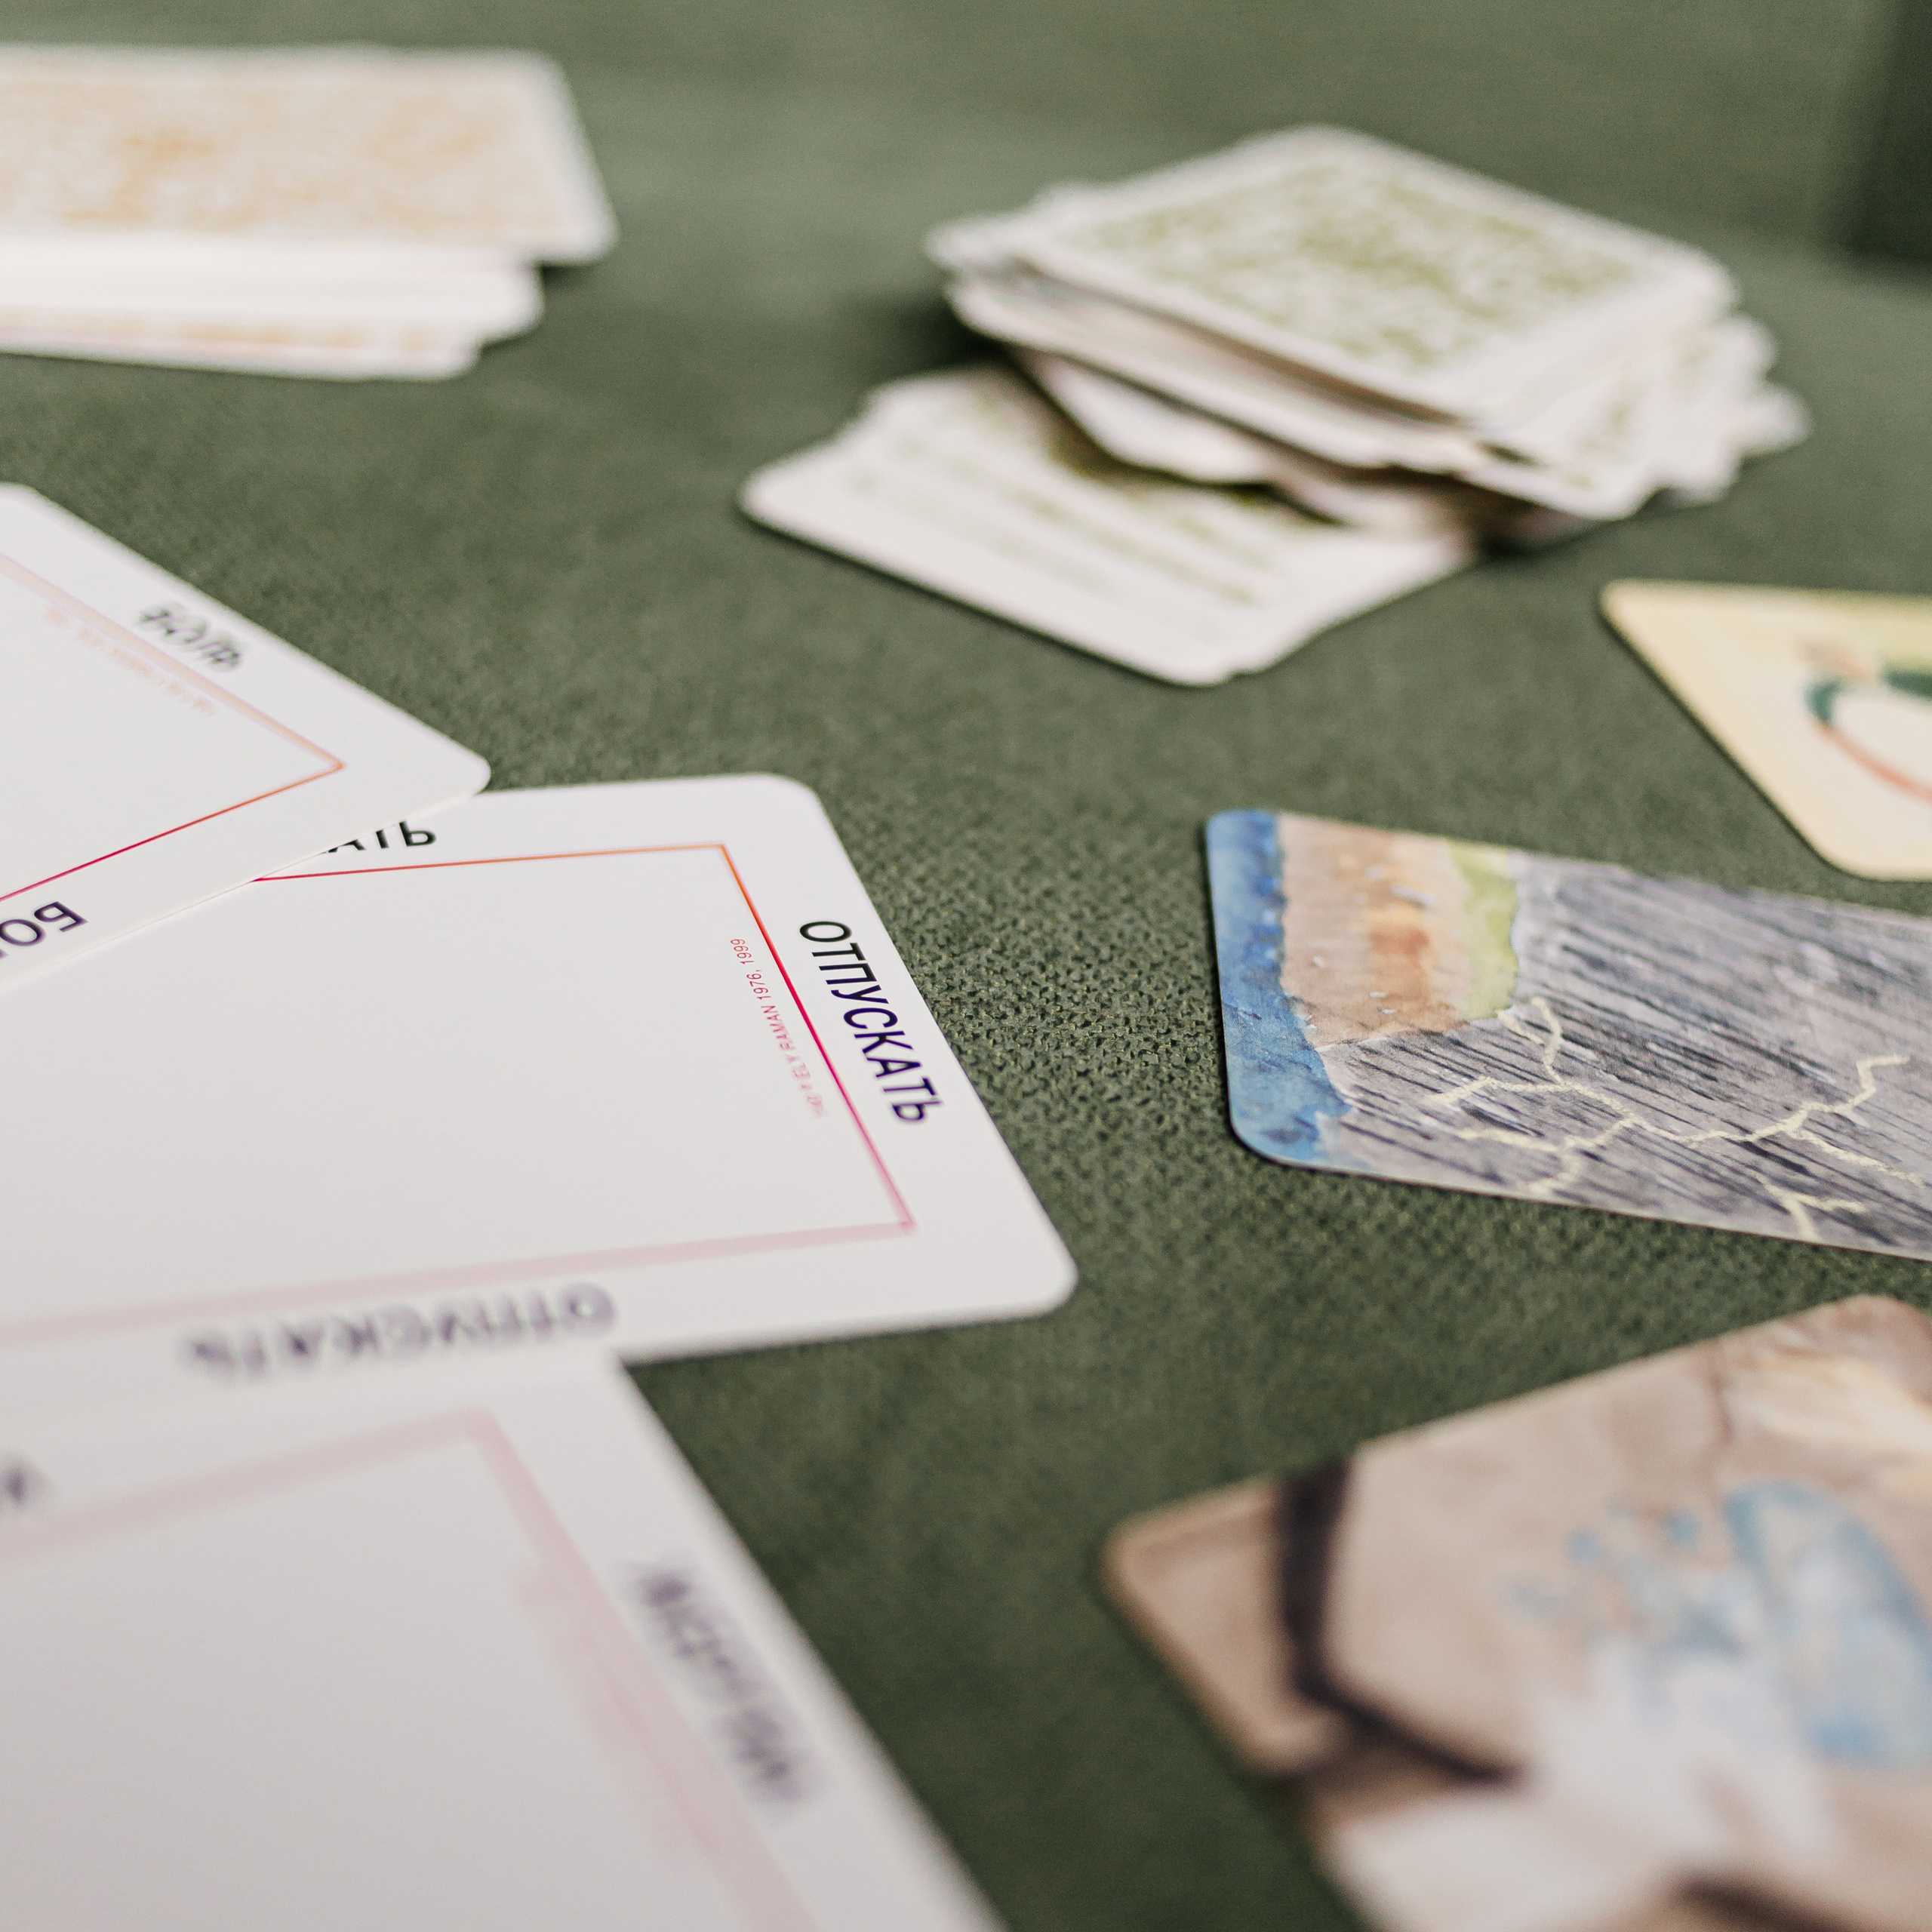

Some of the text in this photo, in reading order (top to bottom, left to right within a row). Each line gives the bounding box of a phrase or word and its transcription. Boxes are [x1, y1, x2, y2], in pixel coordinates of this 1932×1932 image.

[0, 901, 88, 959] БО
[730, 938, 755, 965] 1999
[746, 969, 771, 1001] 1976,
[799, 921, 942, 1122] ОТПУСКАТЬ
